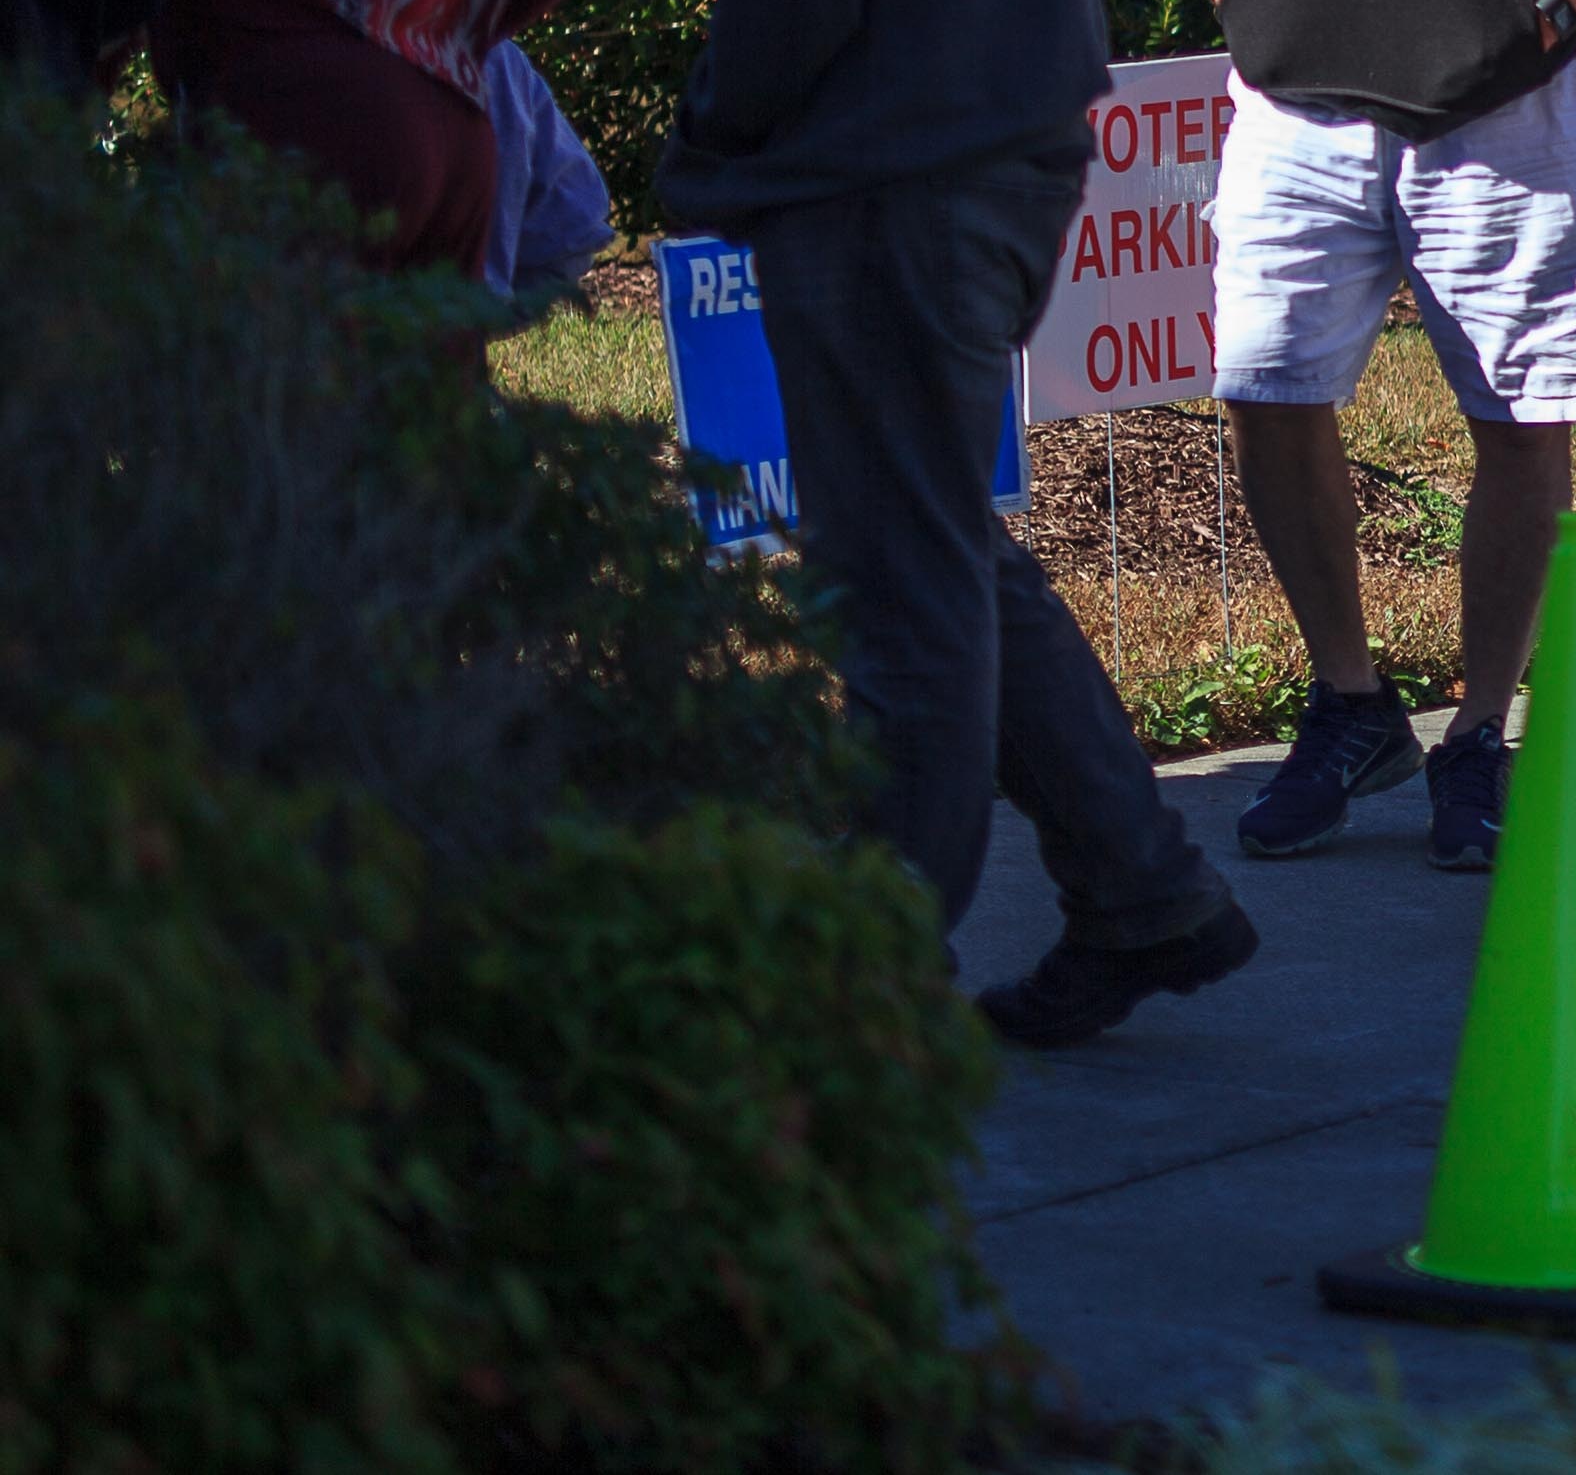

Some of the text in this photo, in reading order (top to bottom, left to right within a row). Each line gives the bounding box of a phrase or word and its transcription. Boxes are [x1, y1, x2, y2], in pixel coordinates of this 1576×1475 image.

[1087, 96, 1236, 173] OTE
[1058, 200, 1213, 283] ARKI
[715, 458, 798, 531] AN
